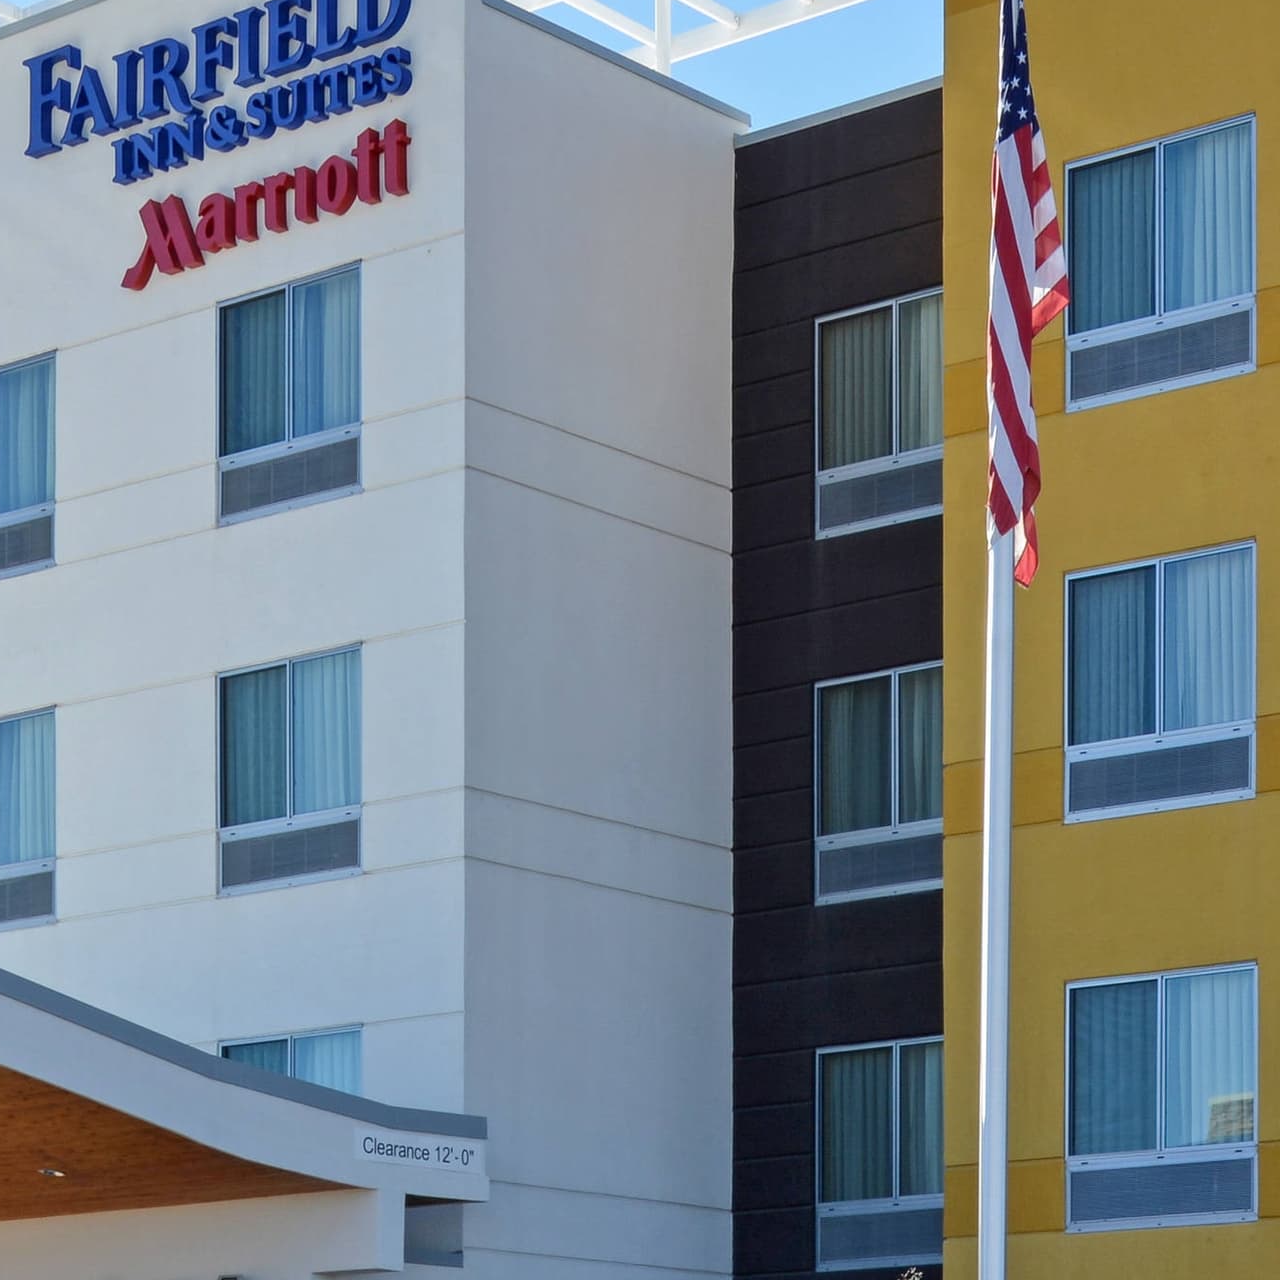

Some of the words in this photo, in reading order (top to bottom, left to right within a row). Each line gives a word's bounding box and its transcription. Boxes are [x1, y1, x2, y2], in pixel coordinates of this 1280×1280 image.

[111, 114, 205, 185] INN
[204, 104, 249, 152] &
[246, 46, 413, 140] SUITES
[120, 118, 412, 291] Marriott
[362, 1136, 430, 1162] Clearance
